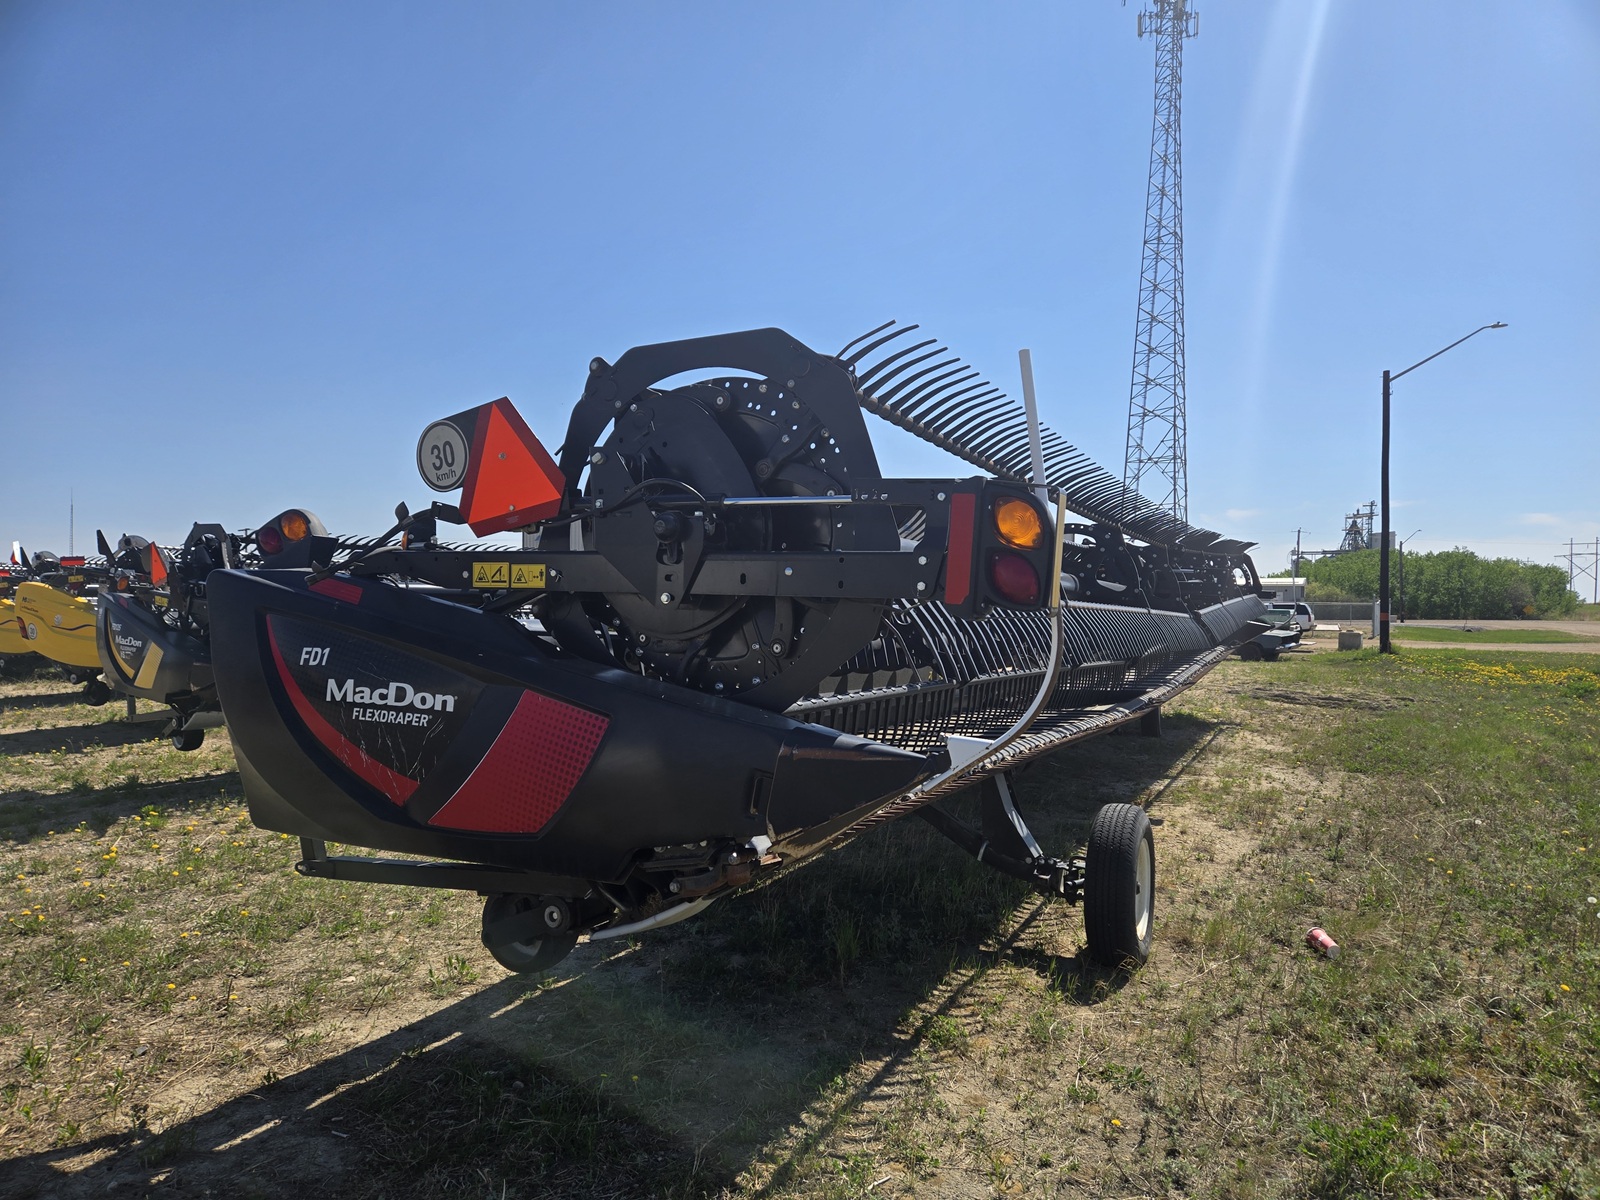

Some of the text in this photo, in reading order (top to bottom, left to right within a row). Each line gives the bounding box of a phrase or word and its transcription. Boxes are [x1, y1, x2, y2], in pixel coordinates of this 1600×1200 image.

[430, 440, 455, 471] 30
[435, 469, 457, 482] km/h
[115, 635, 142, 647] MacDon
[299, 647, 330, 666] FD1
[325, 678, 456, 713] MacDon
[352, 707, 429, 727] FLEXDRAPER
